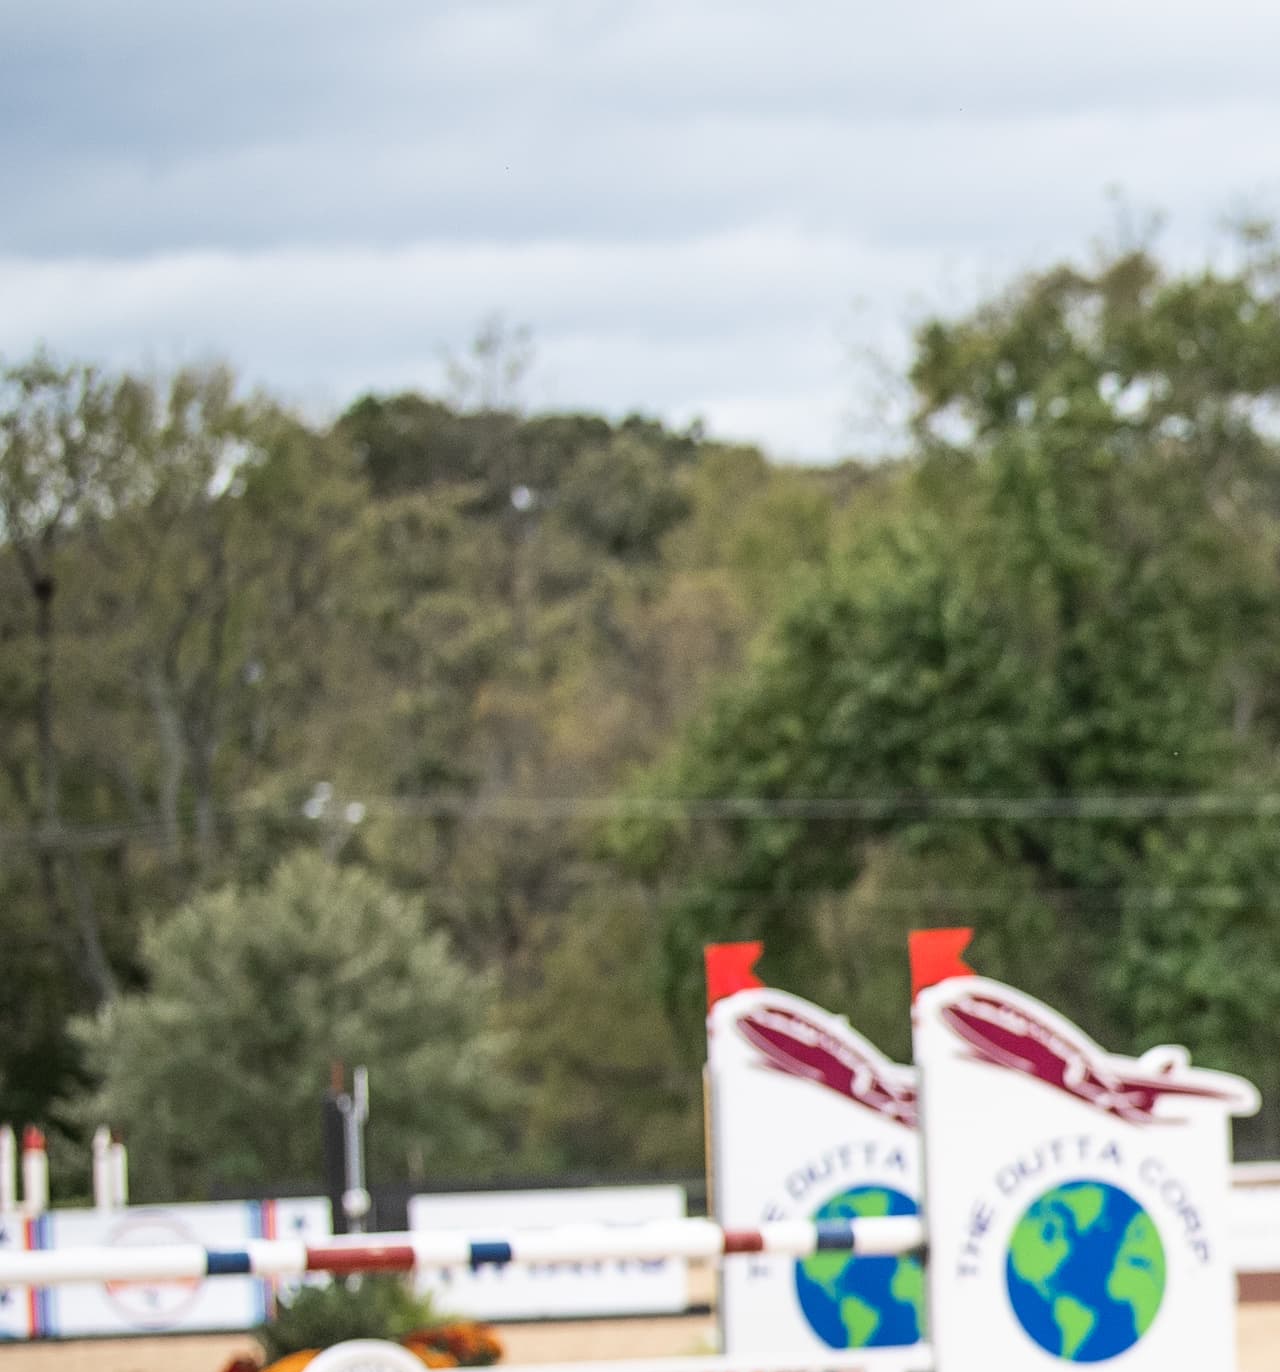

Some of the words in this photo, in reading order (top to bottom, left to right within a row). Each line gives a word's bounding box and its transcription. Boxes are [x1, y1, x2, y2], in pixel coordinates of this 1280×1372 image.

[785, 1142, 907, 1201] DUTTA
[955, 1199, 995, 1278] THE
[994, 1134, 1122, 1194] DUTTA
